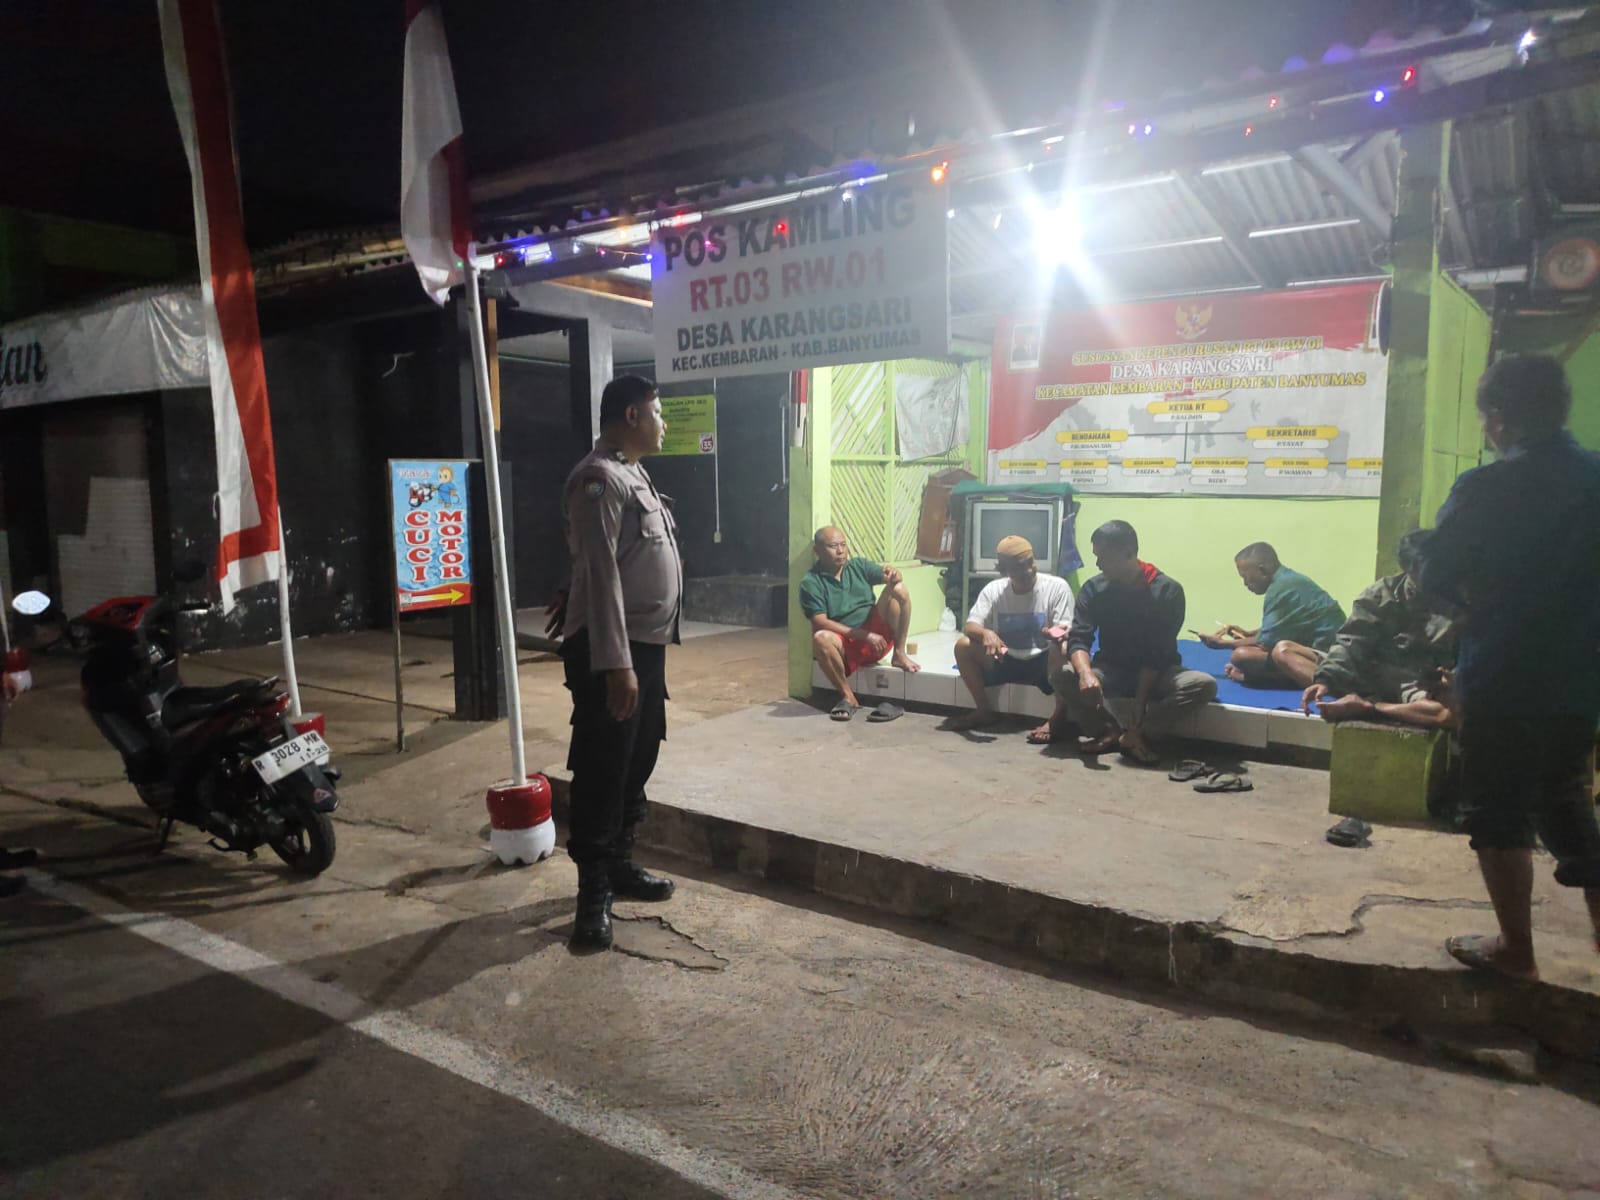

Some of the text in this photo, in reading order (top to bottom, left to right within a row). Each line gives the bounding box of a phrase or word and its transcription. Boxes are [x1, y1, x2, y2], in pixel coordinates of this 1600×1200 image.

[665, 187, 916, 271] POS KAMLING
[689, 250, 885, 313] RT.03 RW.01
[676, 297, 912, 351] DESA KARANGSARI
[672, 345, 779, 373] KEC.KEMBARAN
[791, 328, 921, 358] KAB.BANYUMAS
[1242, 340, 1259, 353] RT
[1280, 338, 1304, 351] RW
[1111, 356, 1274, 380] DESA KARANGSARI
[1036, 384, 1109, 399] KECAMATAN
[1111, 378, 1184, 395] KEMBARAN
[1193, 374, 1277, 391] KABUPATEN
[1279, 371, 1367, 388] BANYUMAS
[1168, 402, 1205, 412] KETUA RT
[1071, 432, 1111, 441] BENDAHARA
[1266, 429, 1317, 437] SEKRETARIS
[405, 510, 431, 582] CUCI
[437, 510, 465, 579] MOTOR
[254, 759, 266, 771] R
[271, 741, 301, 761] 3028
